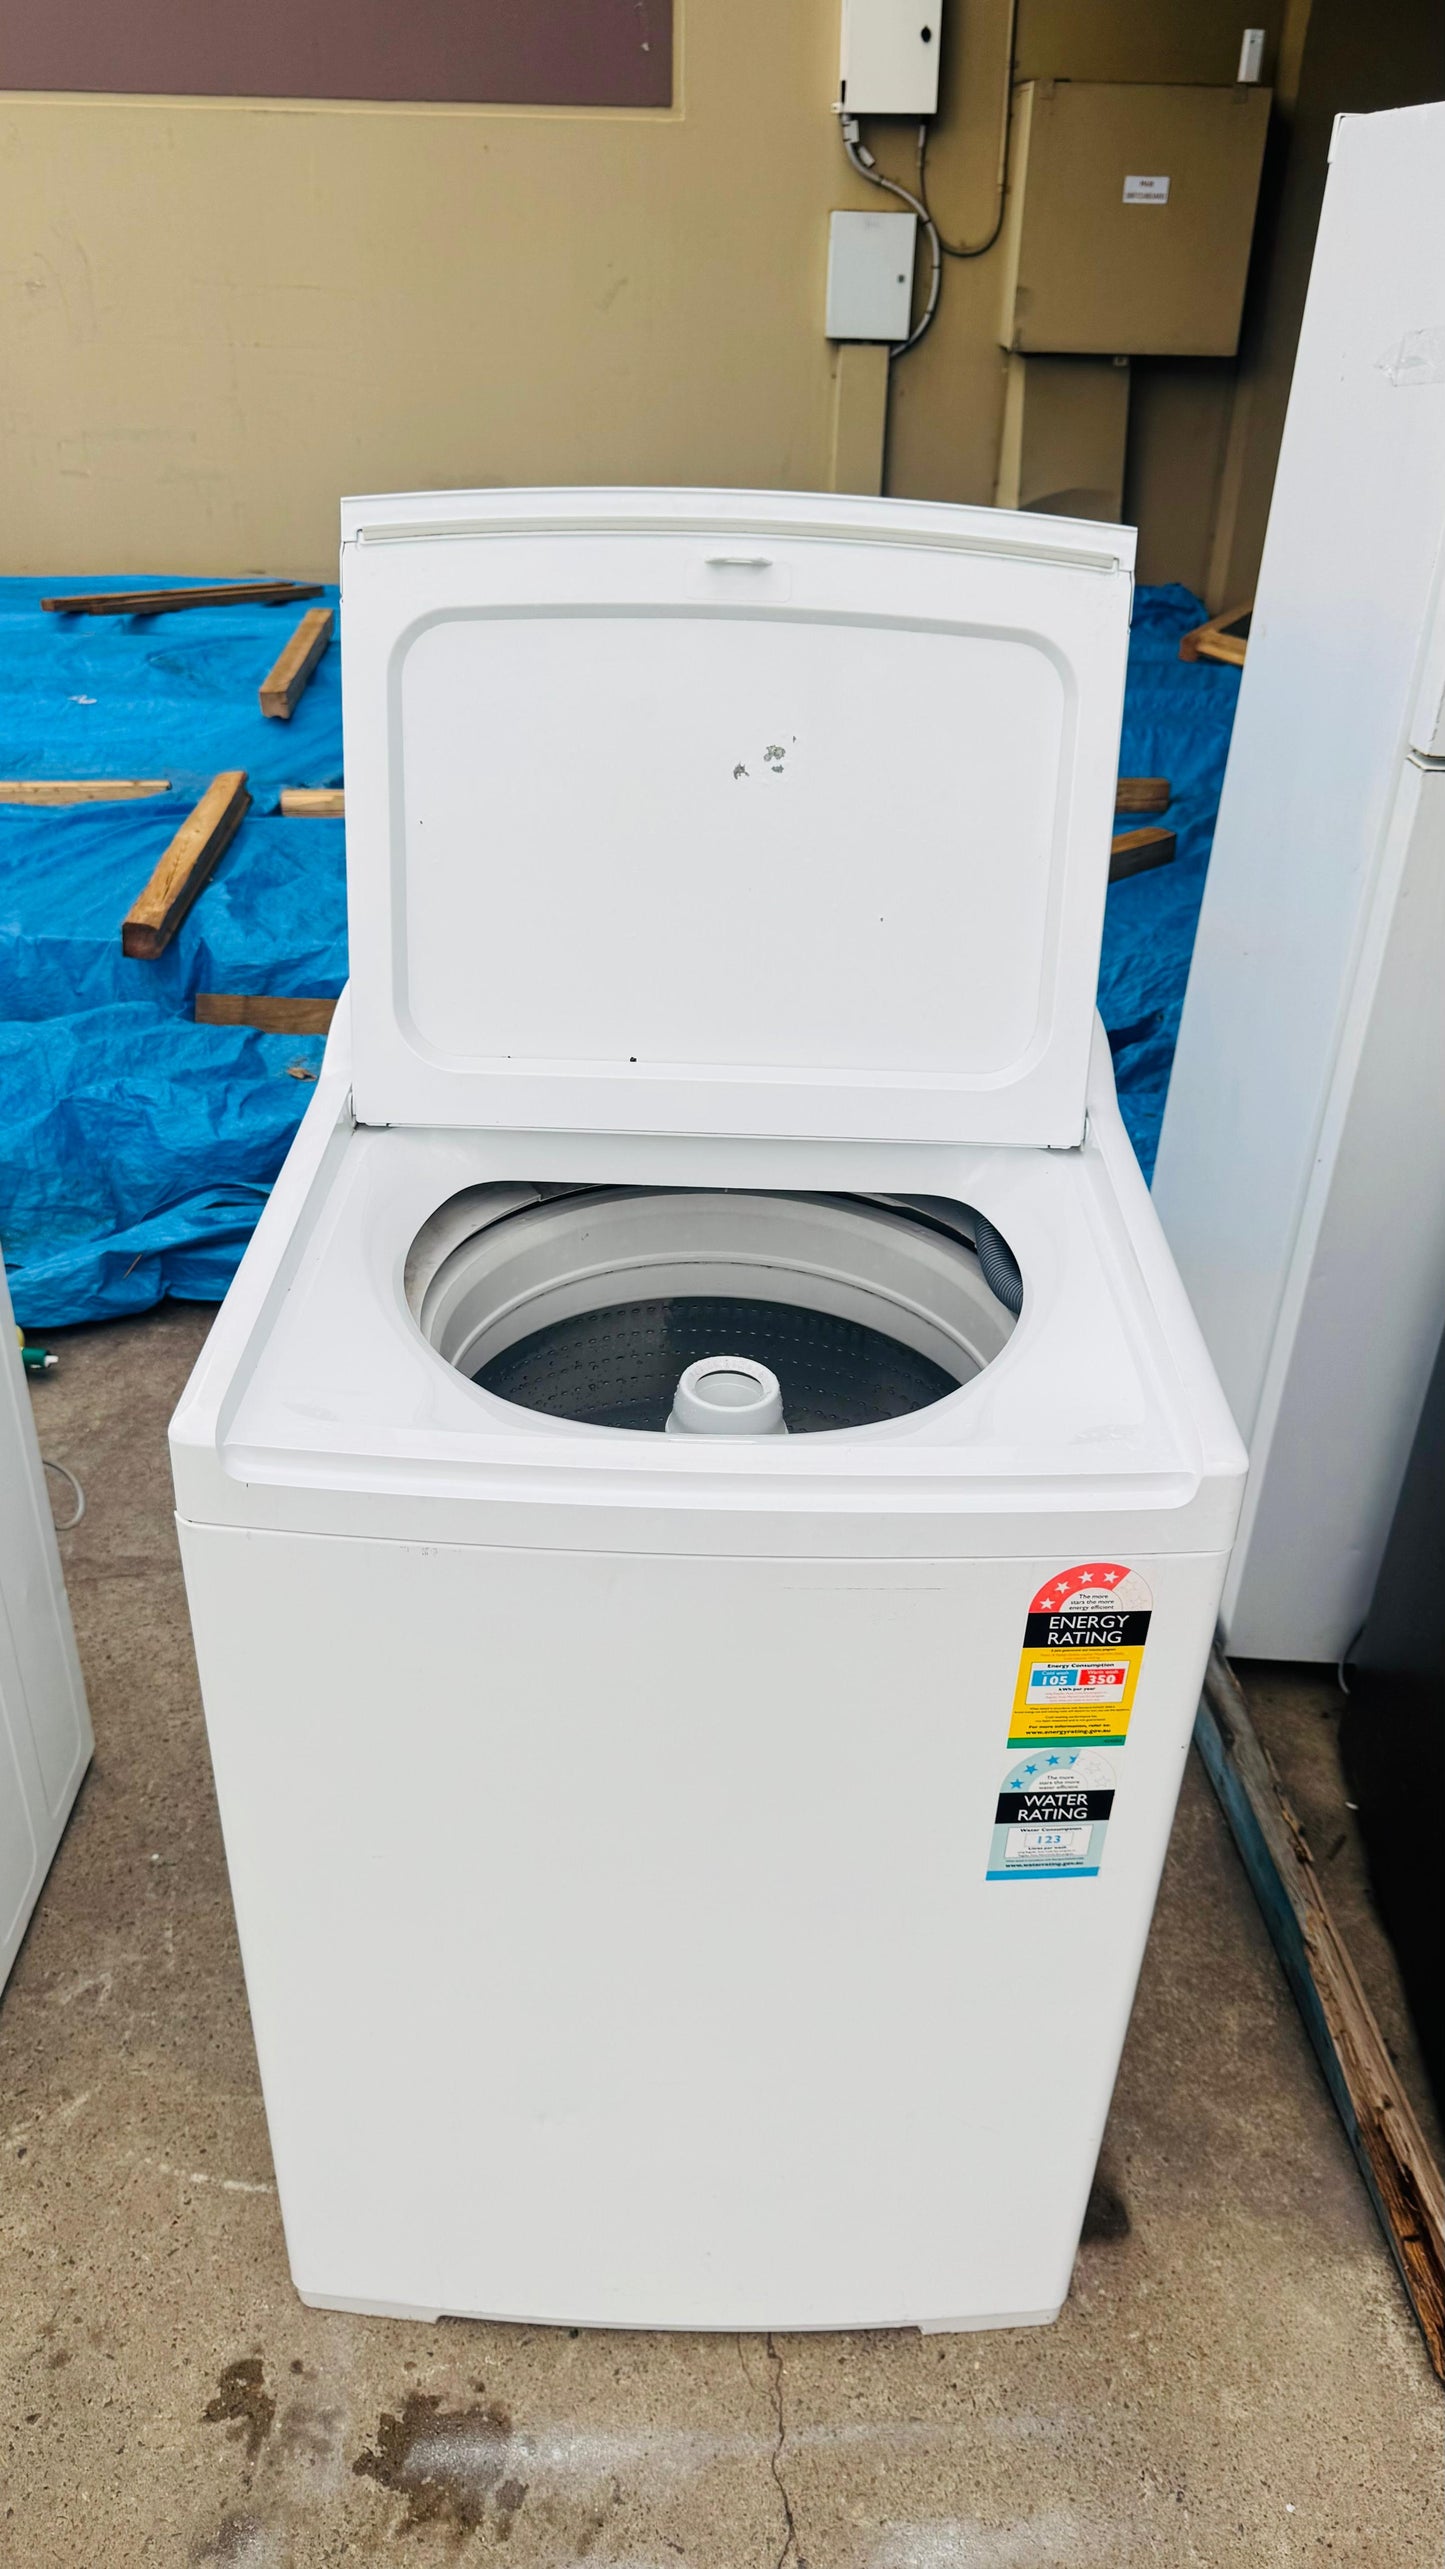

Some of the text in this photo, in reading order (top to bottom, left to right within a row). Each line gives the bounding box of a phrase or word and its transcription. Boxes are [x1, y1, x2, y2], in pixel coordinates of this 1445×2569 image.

[1049, 1615, 1130, 1629] ENERGY
[1047, 1631, 1123, 1645] RATING
[1042, 1676, 1068, 1685] 105
[1087, 1674, 1116, 1684] 350
[1024, 1794, 1088, 1806] WATER
[1018, 1808, 1088, 1821] RATING
[1038, 1835, 1061, 1844] 123
